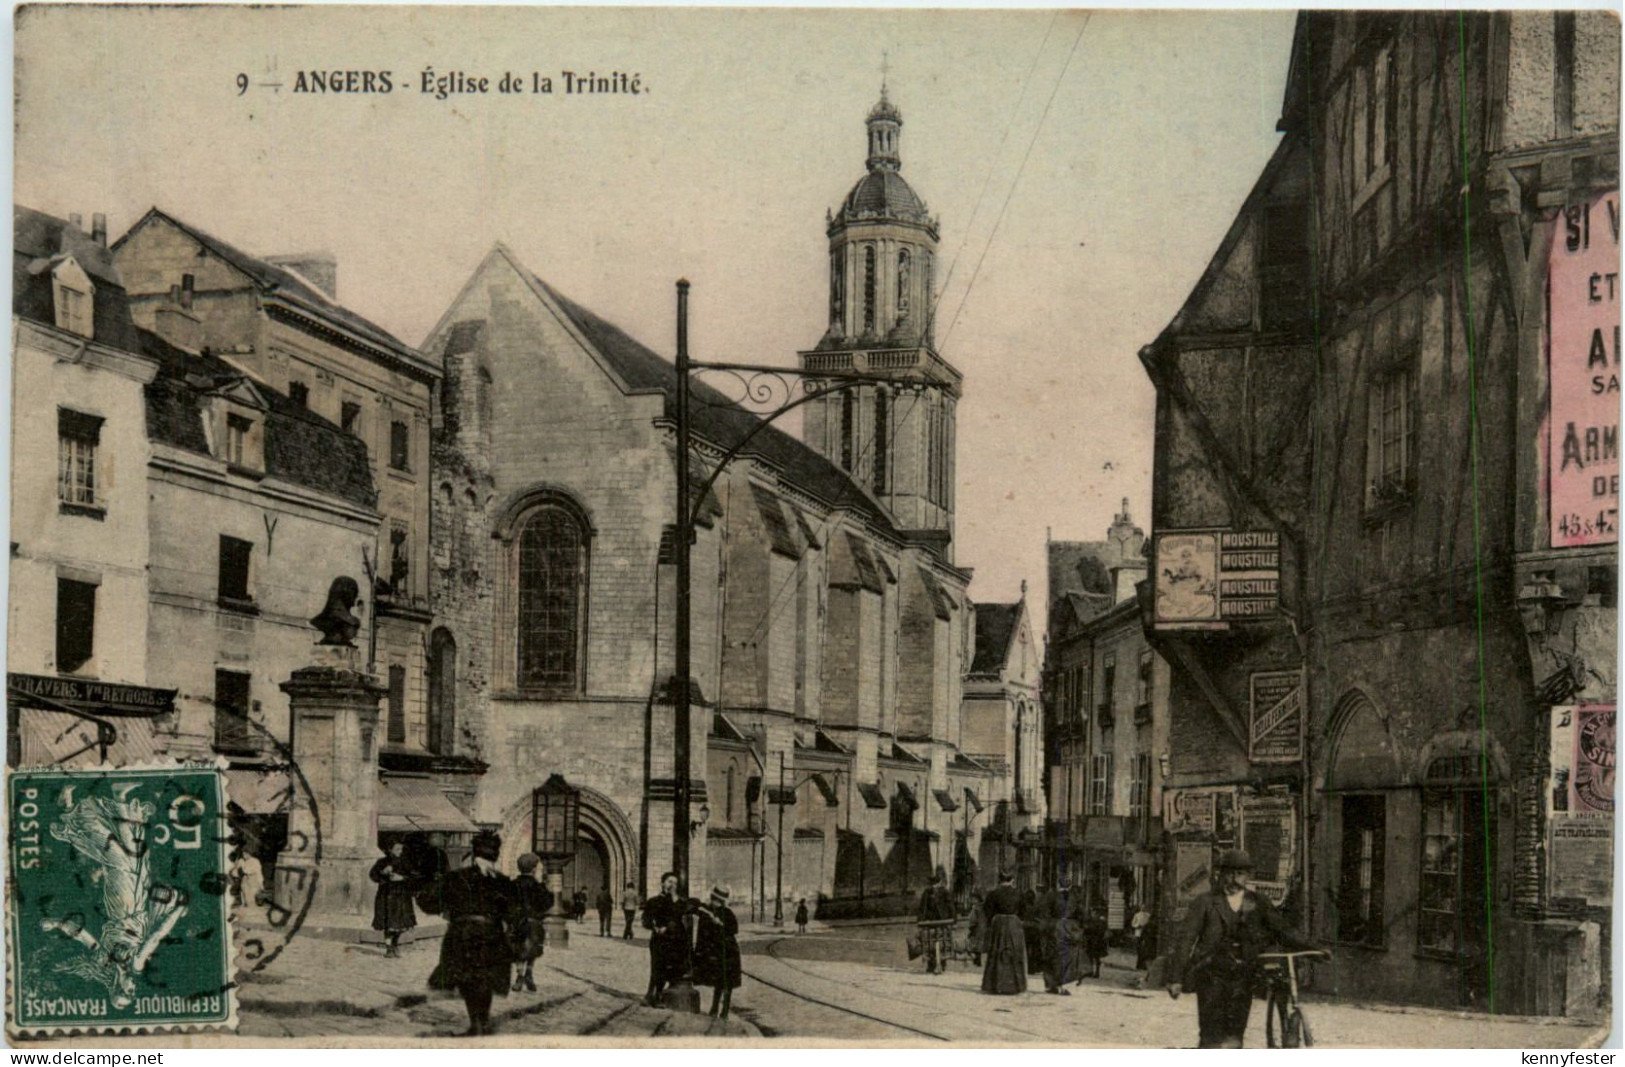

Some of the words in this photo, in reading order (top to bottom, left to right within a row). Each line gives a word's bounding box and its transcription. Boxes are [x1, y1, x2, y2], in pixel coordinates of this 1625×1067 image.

[1566, 203, 1590, 252] SI
[1222, 532, 1279, 547] MOUSTILLE
[1222, 553, 1279, 568] MOUSTILLE
[1221, 580, 1277, 595] MOUSTILLE
[19, 787, 39, 871] POSTES
[25, 997, 108, 1018] FRANÇAISE
